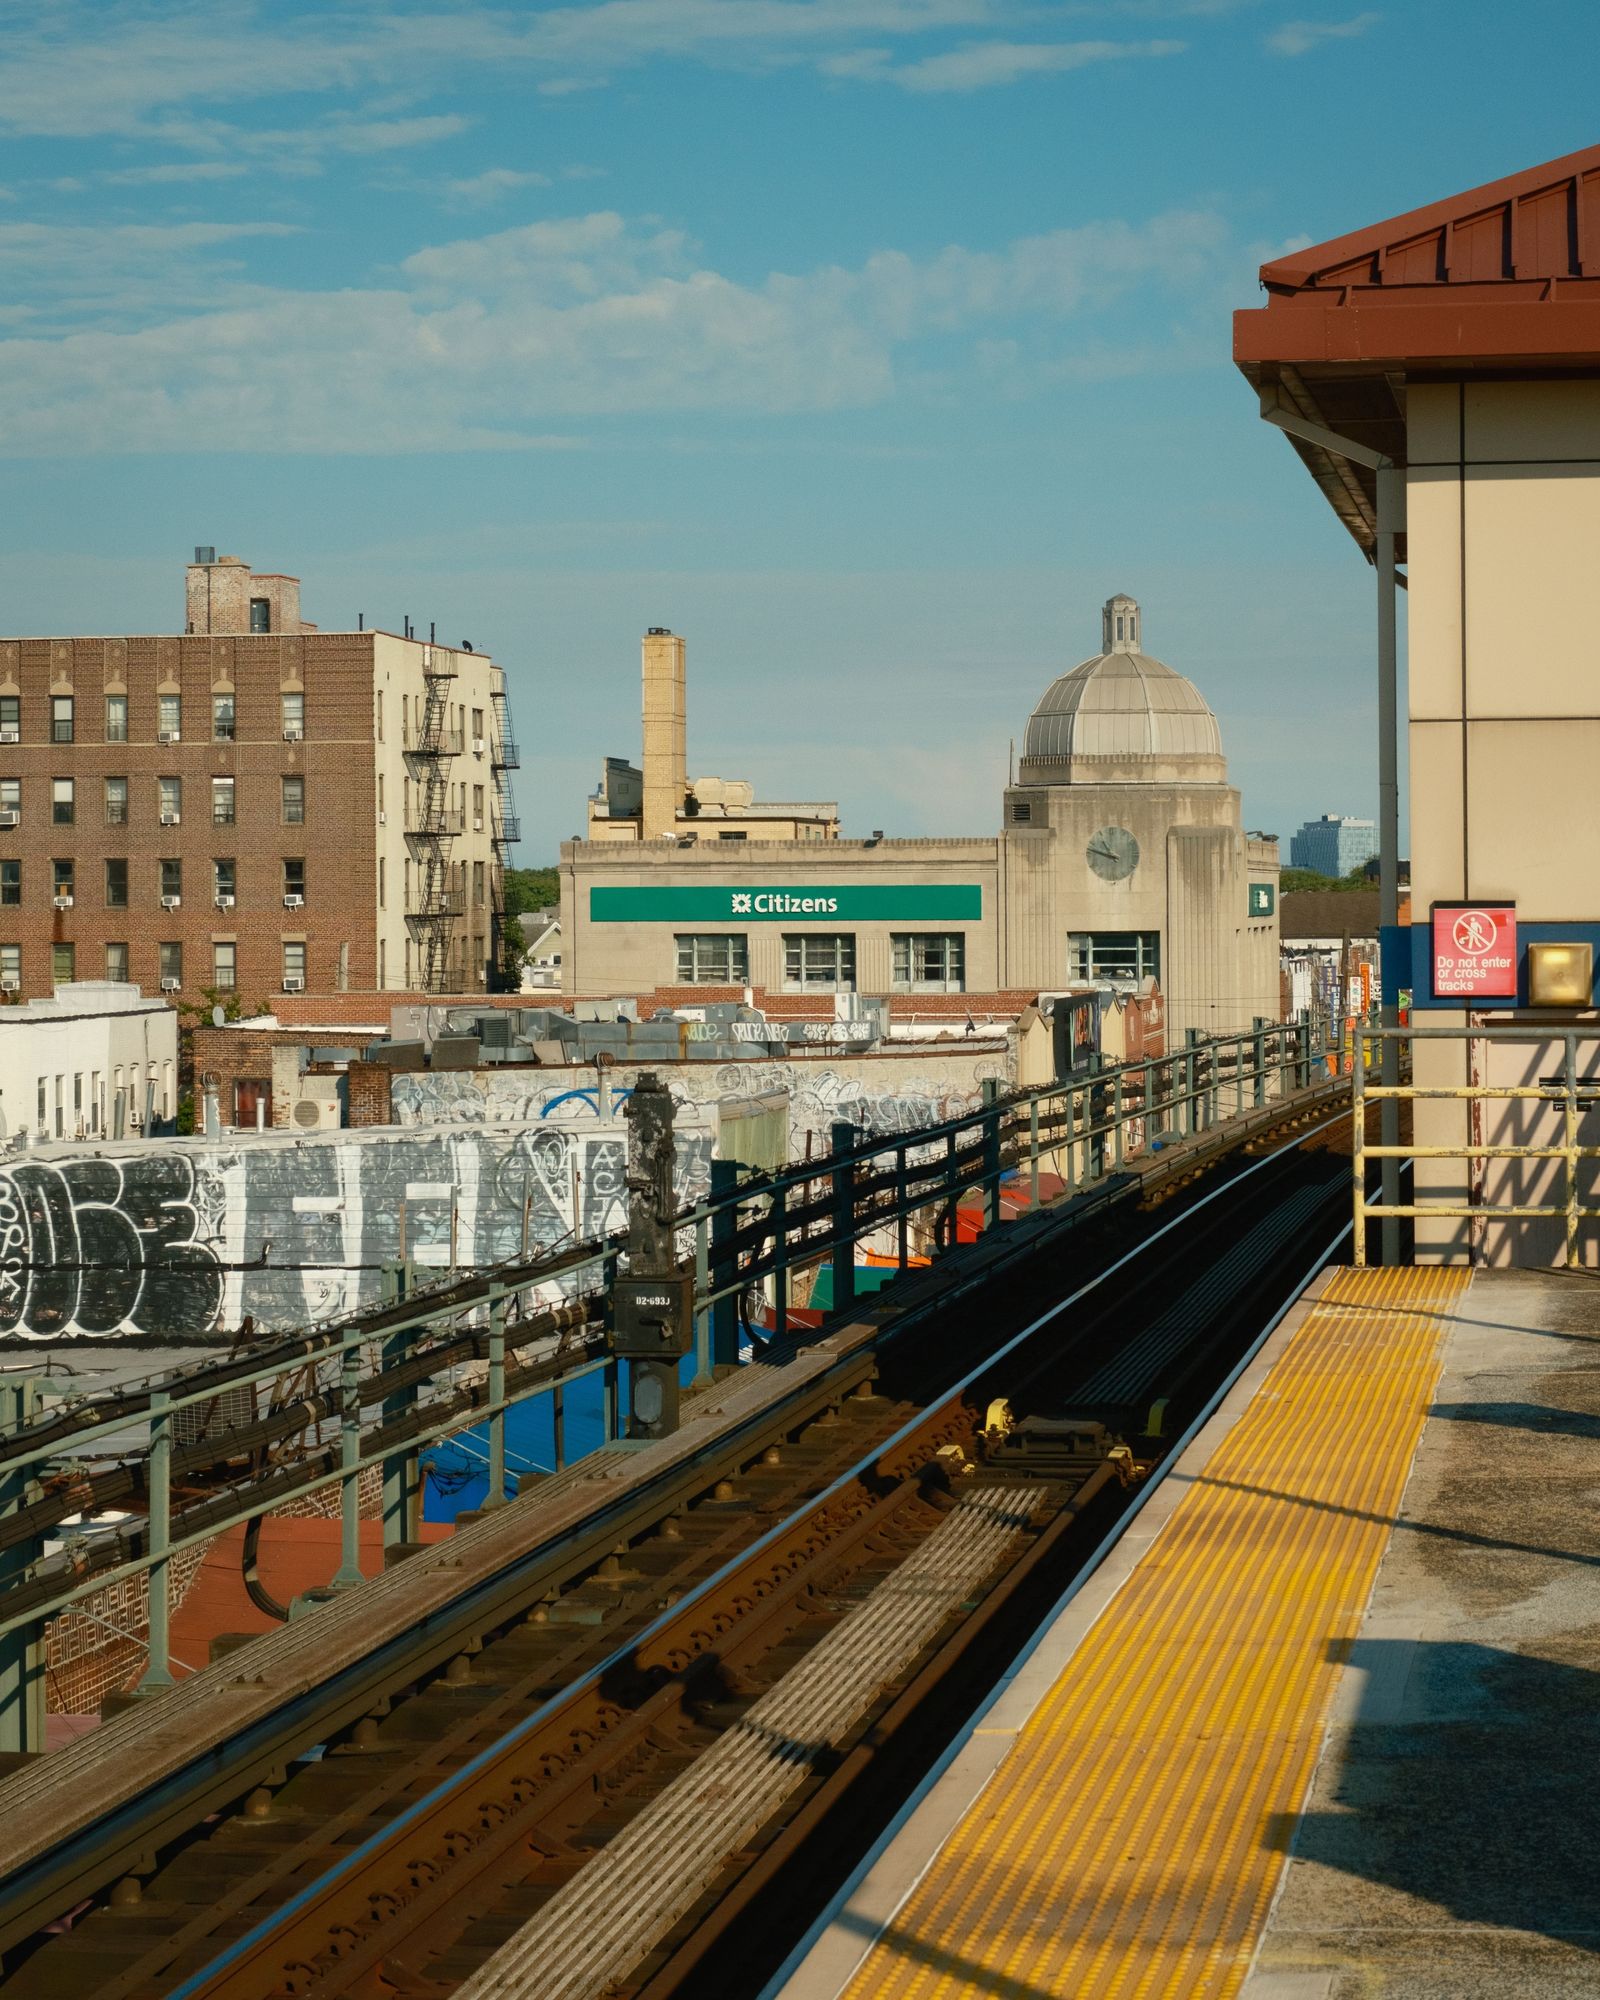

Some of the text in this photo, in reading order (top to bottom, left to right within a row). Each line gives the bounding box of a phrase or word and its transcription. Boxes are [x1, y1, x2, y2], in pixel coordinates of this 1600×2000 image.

[754, 893, 838, 913] Citizens
[1437, 956, 1512, 968] Do not enter
[1437, 968, 1487, 978] or cross
[1438, 979, 1474, 991] tracks
